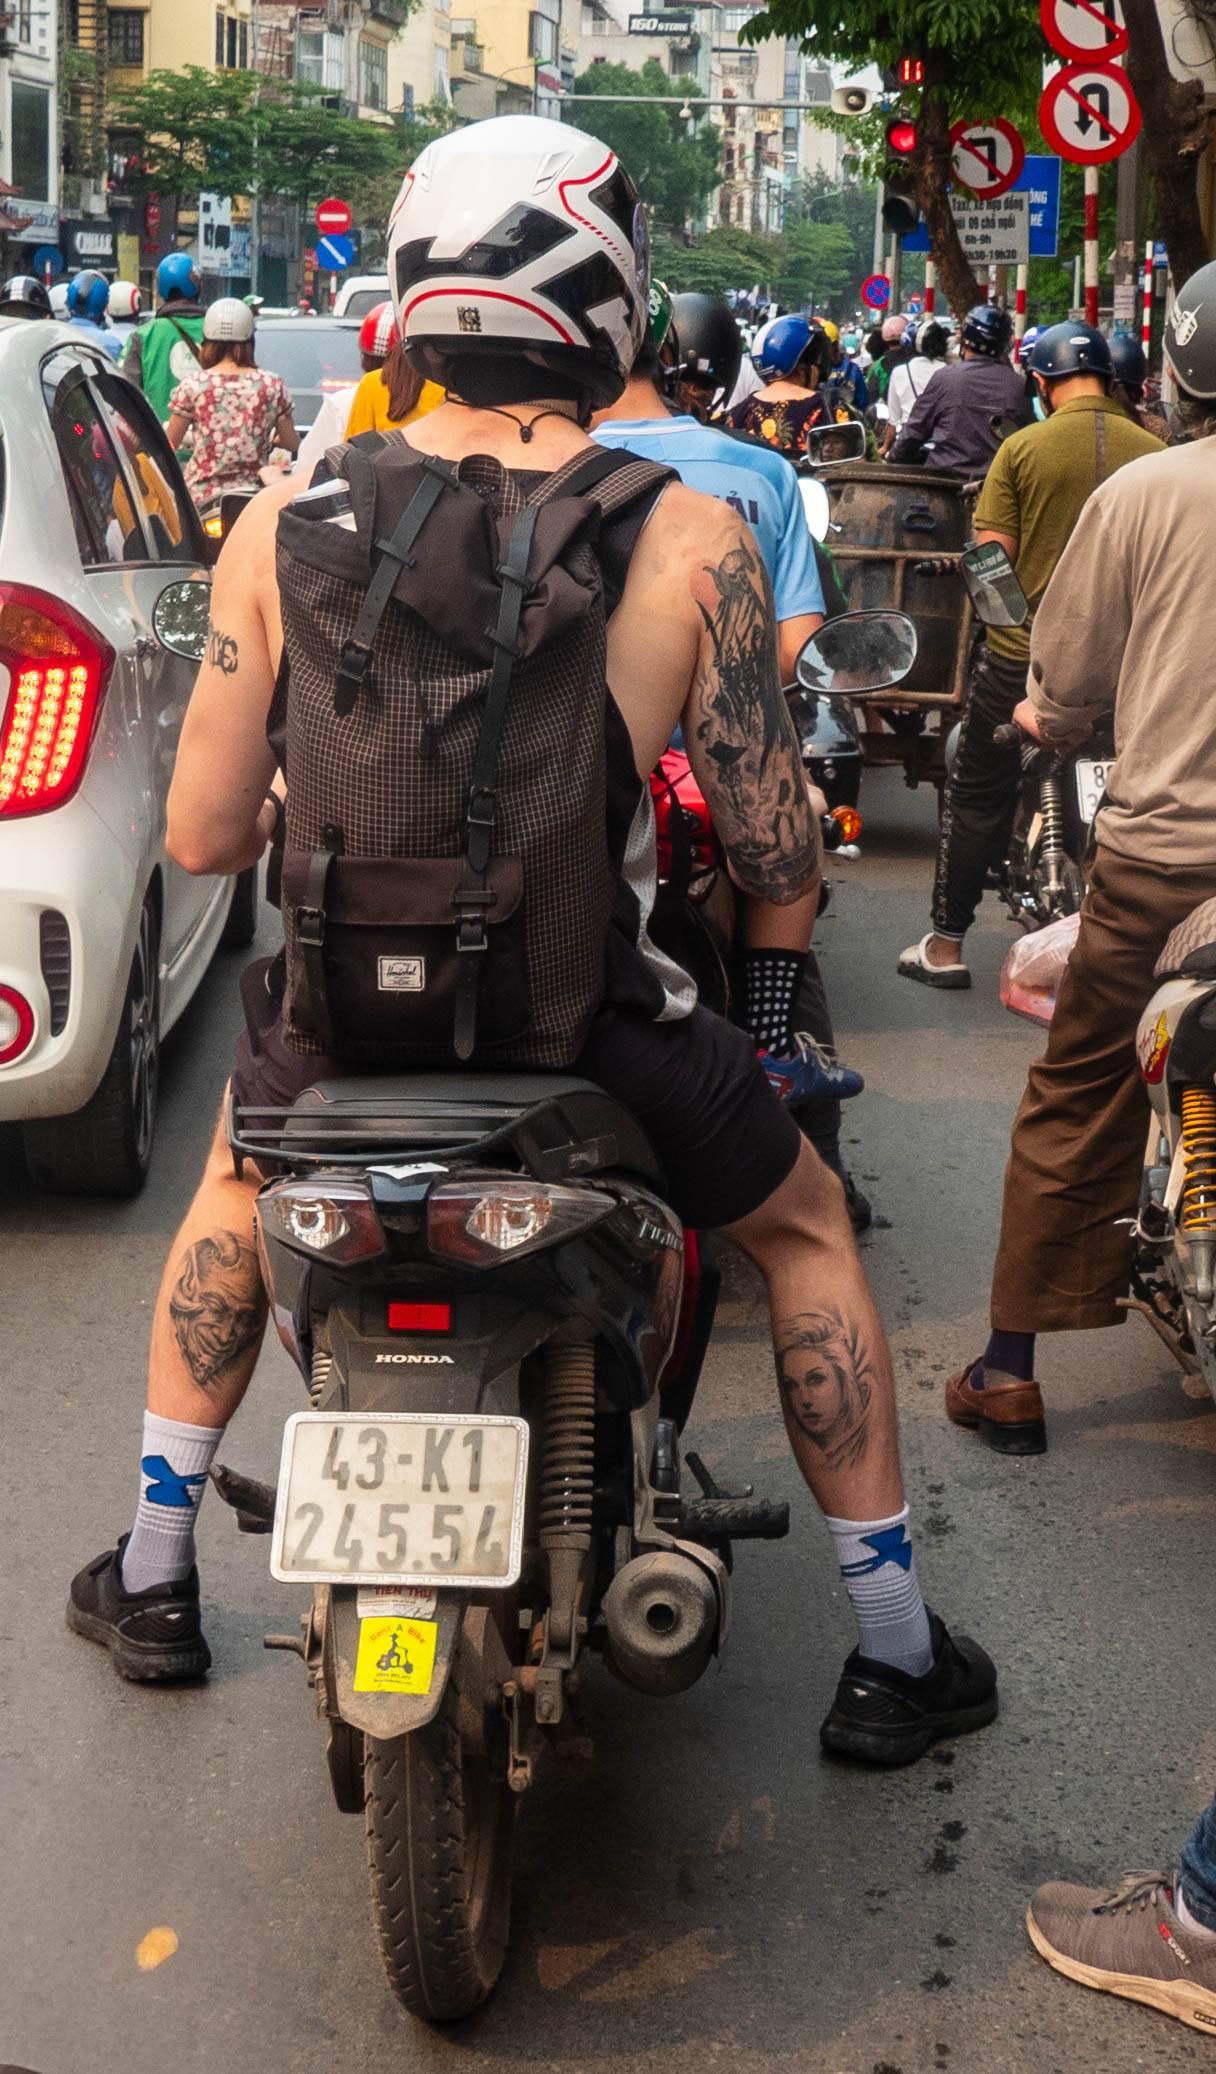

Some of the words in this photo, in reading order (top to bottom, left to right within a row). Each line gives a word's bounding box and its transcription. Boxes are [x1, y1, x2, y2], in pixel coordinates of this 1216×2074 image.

[1094, 765, 1113, 788] 8
[375, 1354, 456, 1364] HONDA
[321, 1426, 484, 1493] 43-K1
[291, 1502, 503, 1571] 245.54
[396, 1623, 404, 1632] A
